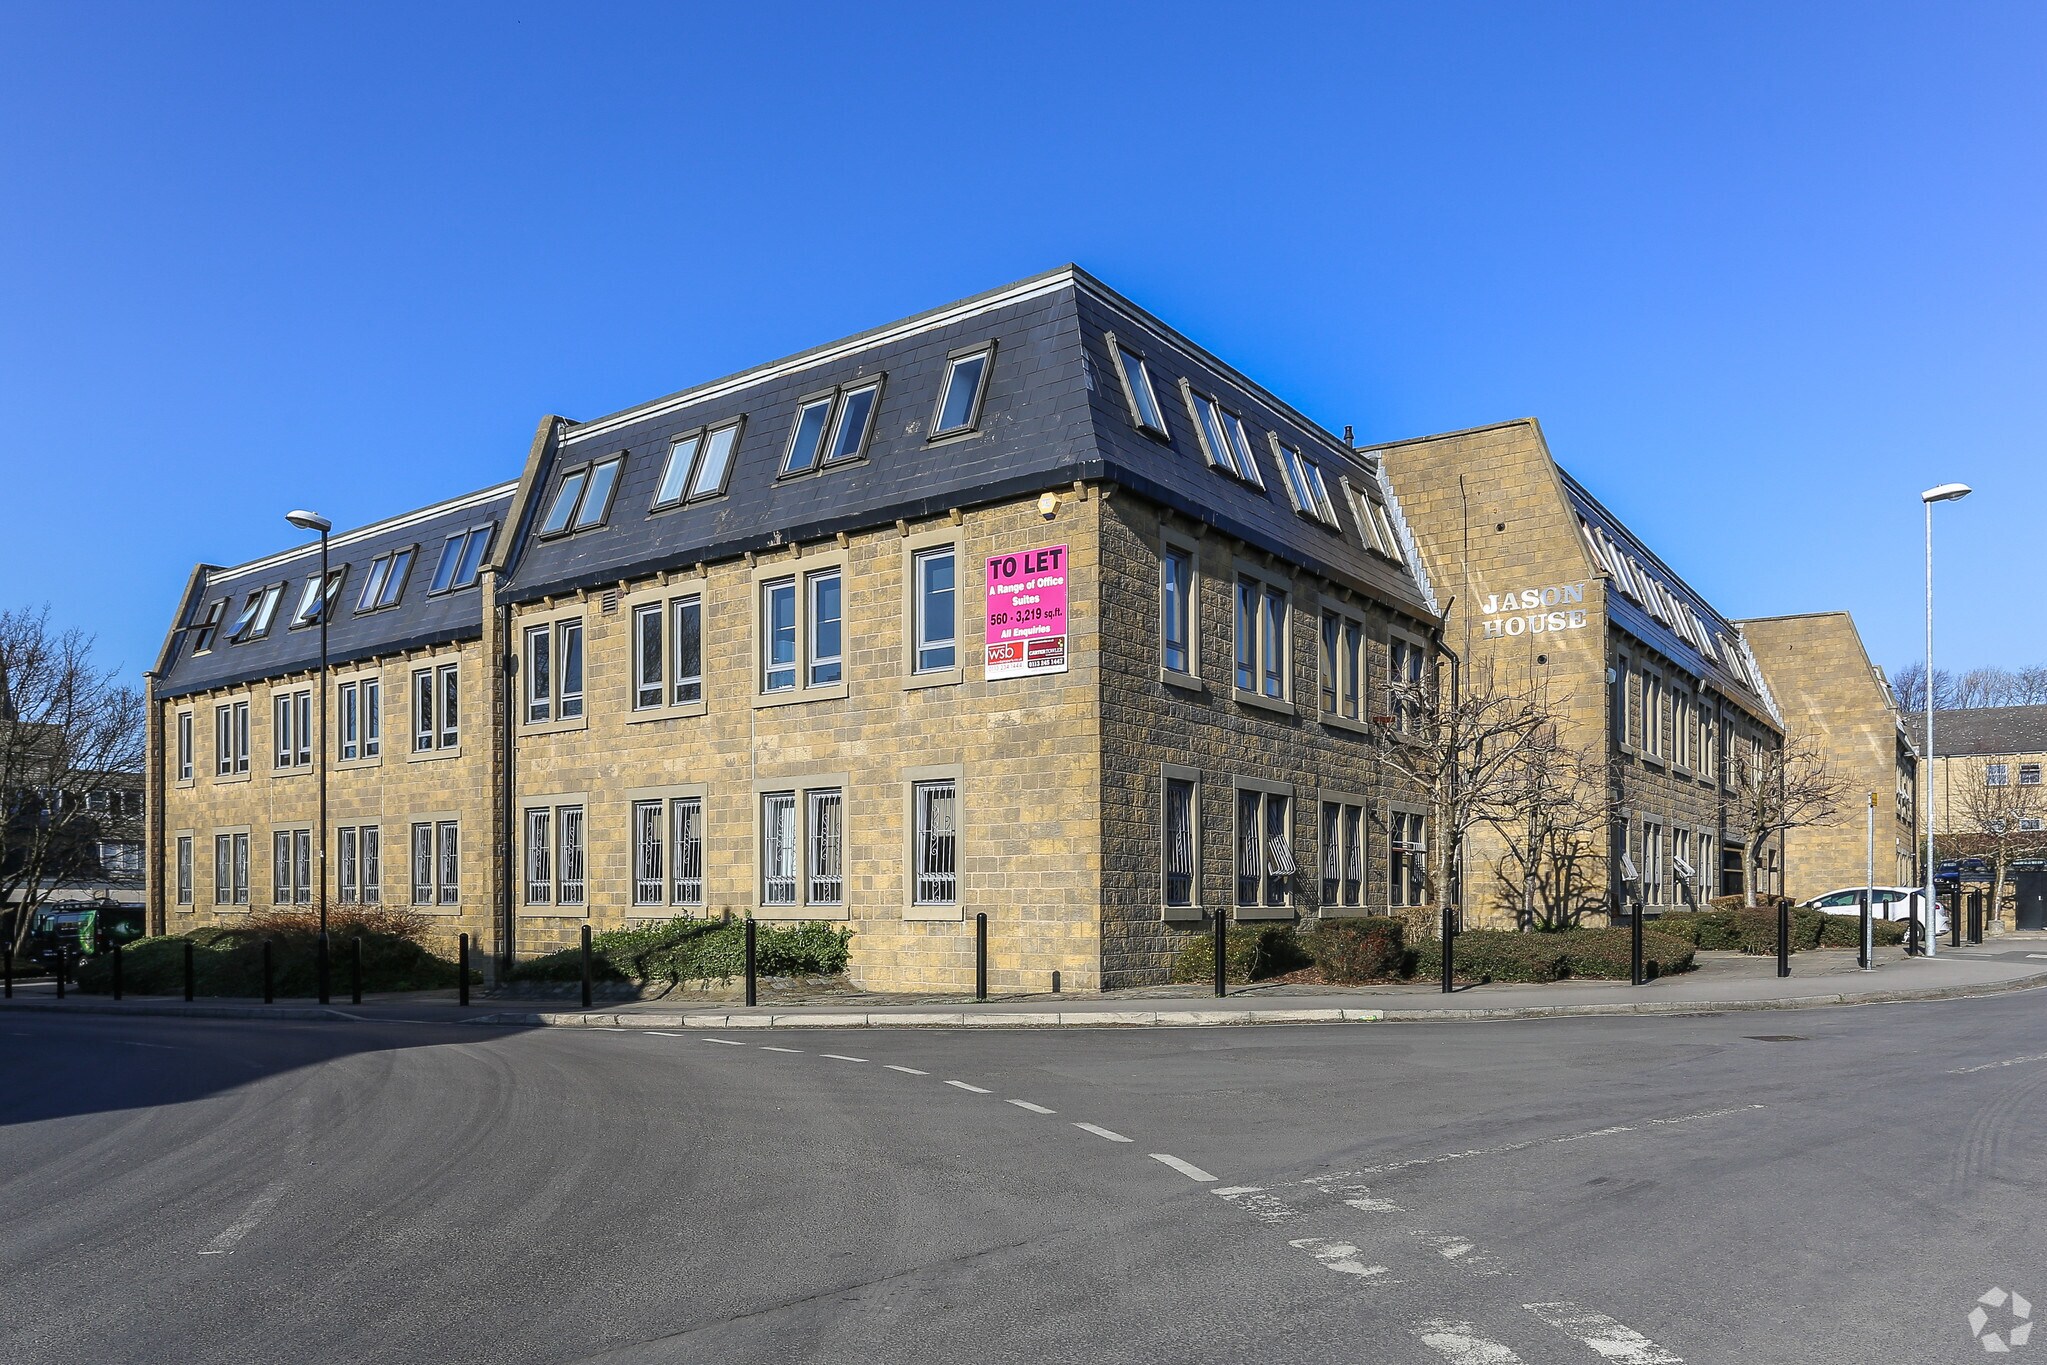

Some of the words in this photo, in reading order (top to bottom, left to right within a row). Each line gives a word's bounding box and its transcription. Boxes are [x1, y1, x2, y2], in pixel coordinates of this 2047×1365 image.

[990, 557, 1017, 579] TO
[1025, 549, 1063, 574] LET
[989, 586, 996, 596] A
[997, 583, 1025, 595] Range
[1026, 579, 1036, 590] of
[1037, 576, 1064, 588] Office
[1012, 595, 1040, 606] Suites
[1482, 583, 1585, 614] JASON
[990, 613, 1008, 625] 560
[1016, 608, 1042, 623] 3,219
[1044, 607, 1063, 619] sq.ft.
[1482, 608, 1587, 640] HOUSE
[1001, 629, 1012, 638] All
[1013, 625, 1050, 637] Enquiries
[988, 643, 1014, 660] wsb
